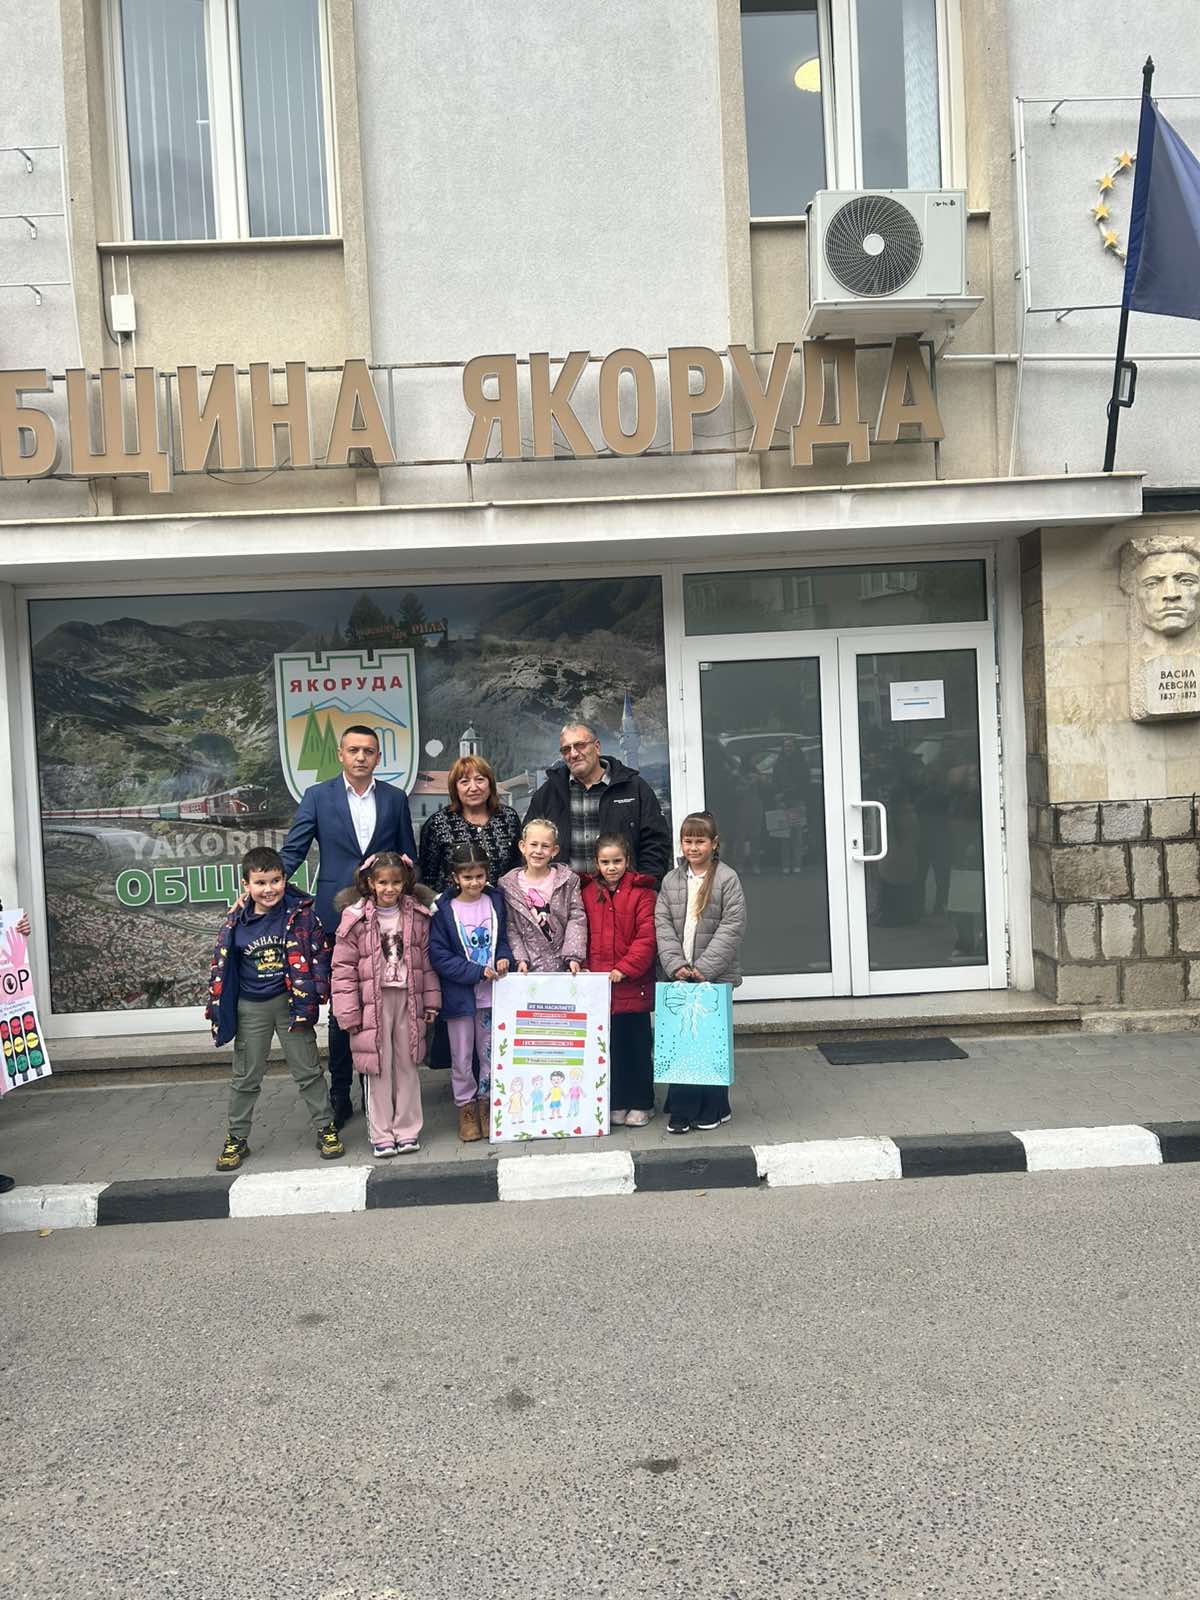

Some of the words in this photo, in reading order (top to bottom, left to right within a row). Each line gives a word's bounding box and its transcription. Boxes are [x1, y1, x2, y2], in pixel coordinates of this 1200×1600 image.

[0, 359, 397, 494] БЩИНА
[462, 337, 946, 466] ЯКОРУДА
[289, 675, 403, 693] ЯКОРУДА
[1158, 680, 1197, 690] ЛЕВСКИ
[1160, 669, 1195, 680] ВАСИЛ
[127, 828, 290, 860] YAKORU
[115, 860, 318, 908] ОБЩ
[243, 935, 286, 956] MANHAT
[0, 969, 30, 995] OP
